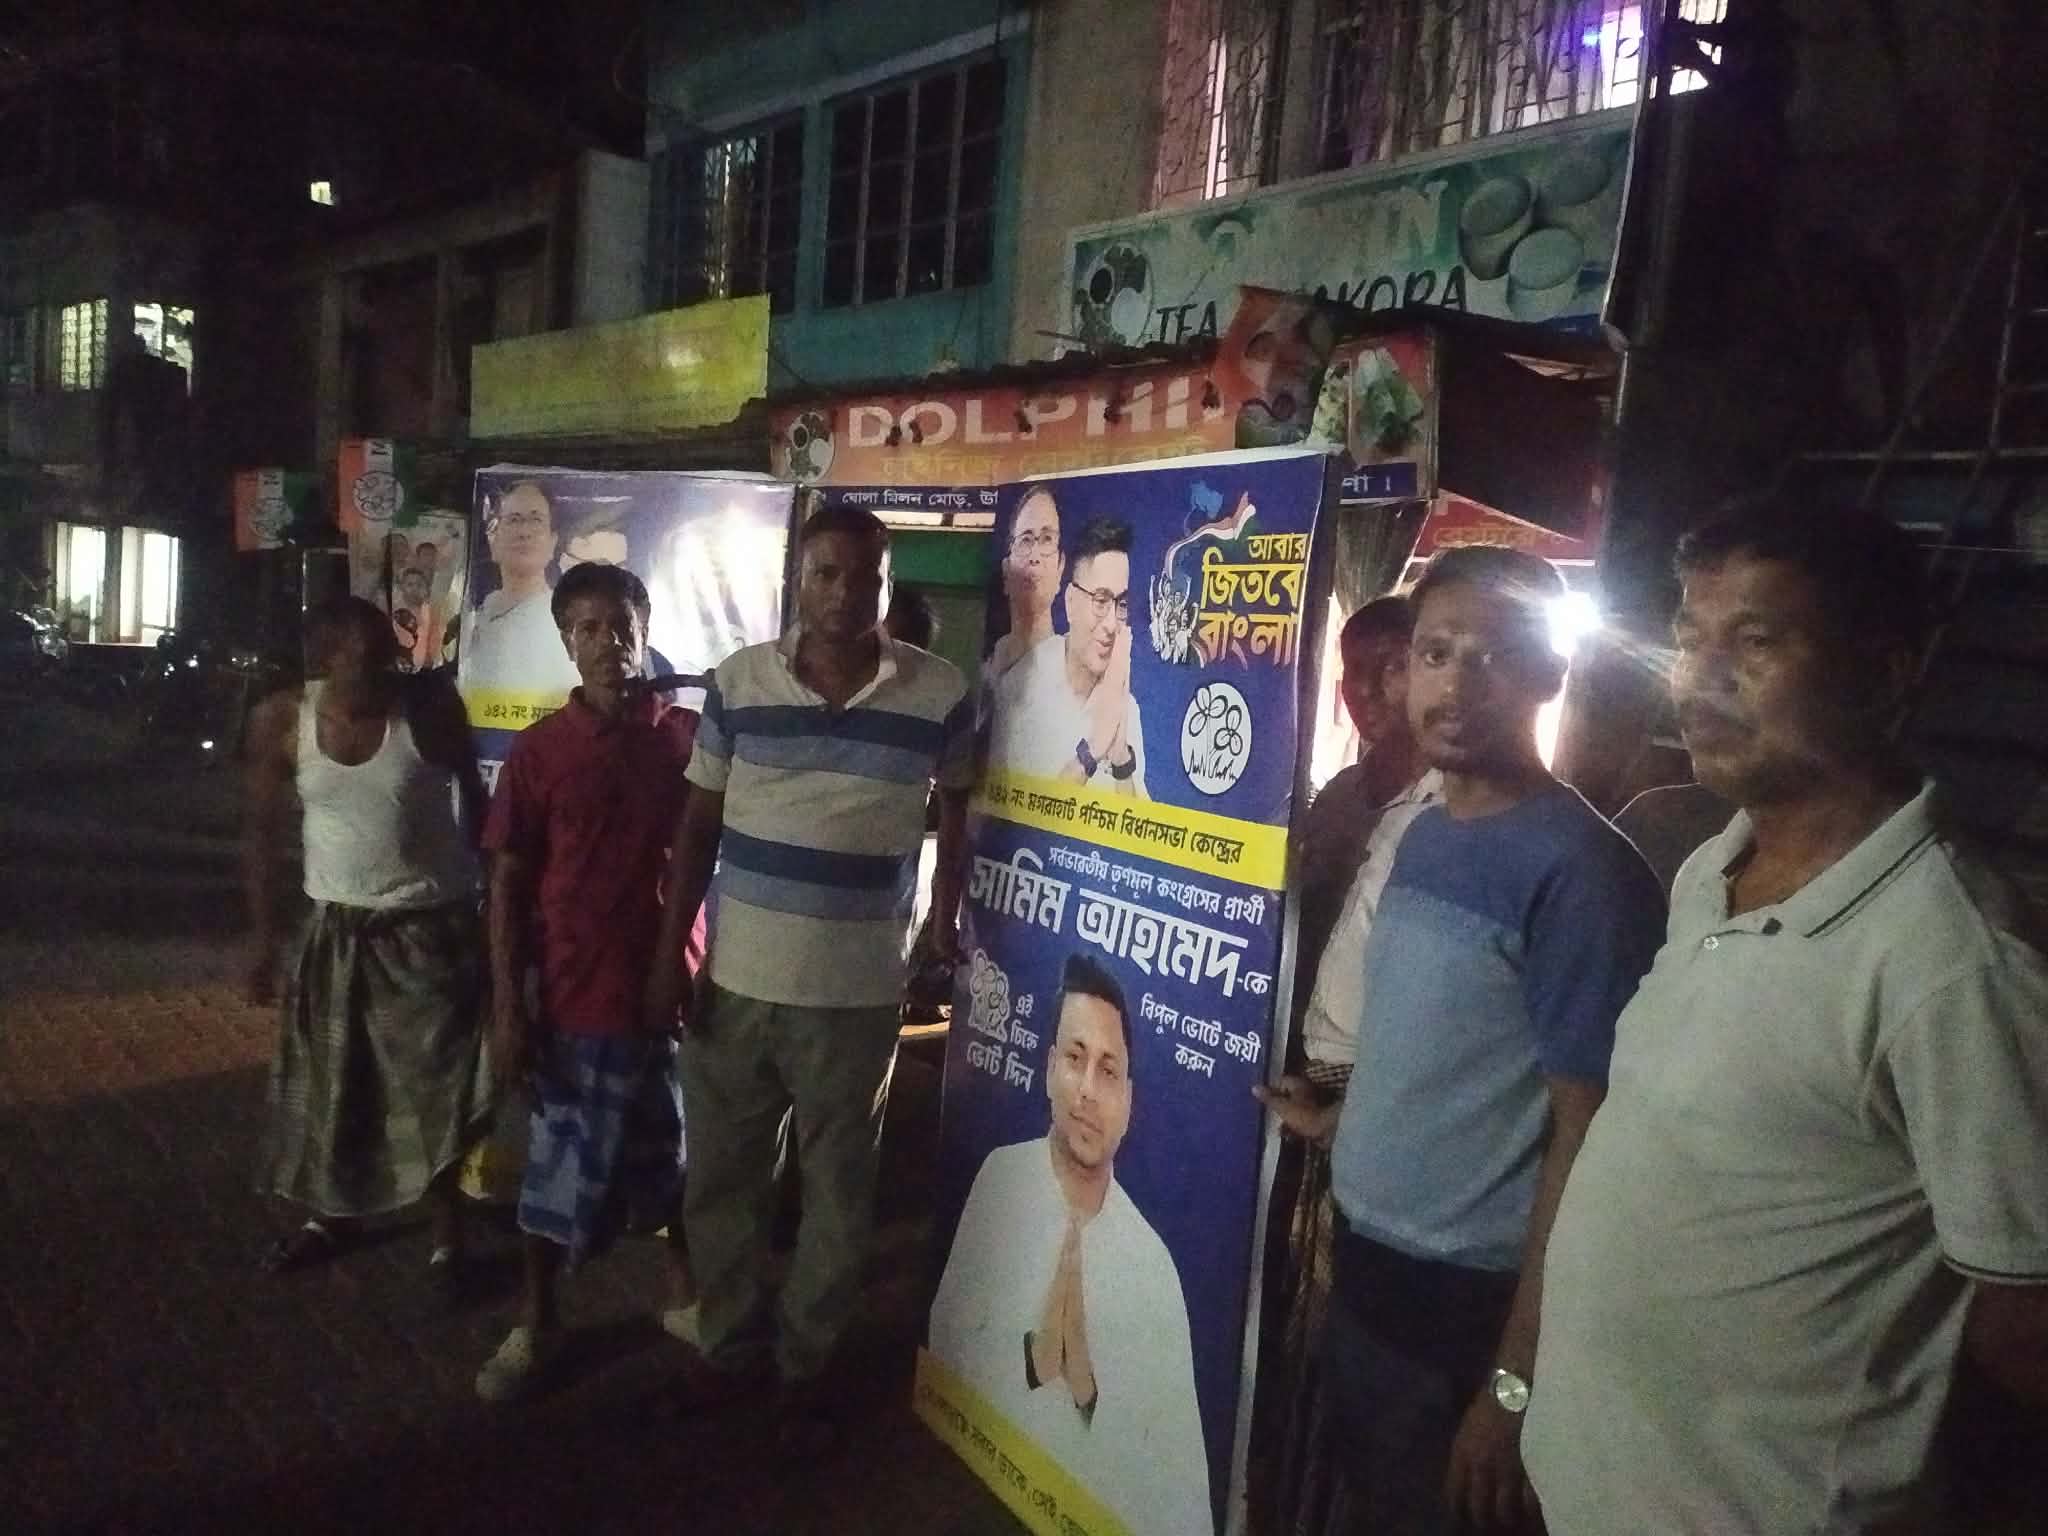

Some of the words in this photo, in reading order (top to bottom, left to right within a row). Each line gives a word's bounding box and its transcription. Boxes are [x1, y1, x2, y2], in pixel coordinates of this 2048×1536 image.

[1247, 533, 1308, 560] আবার
[1200, 547, 1305, 609] জিতবে
[1199, 612, 1298, 670] বাংলা
[511, 705, 528, 719] নং
[1011, 788, 1025, 808] নং
[1027, 793, 1077, 821] মগরাহাট
[1079, 802, 1118, 832] পশ্চিম
[1121, 808, 1188, 849] বিধানসভা
[1190, 831, 1244, 864] কেন্দ্রের
[968, 847, 1071, 935] সামিম
[1049, 846, 1109, 882] সর্বভারতীয়
[1111, 864, 1155, 899] তৃণমূল
[1157, 877, 1221, 915] কংগ্রেসের
[1224, 889, 1266, 926] প্রার্থী
[1015, 994, 1034, 1018] এই
[1140, 992, 1180, 1034] বিপুল
[1181, 1015, 1222, 1047] ভোটে
[1224, 1031, 1262, 1064] জয়ী
[967, 1041, 1003, 1075] ভোট
[1004, 1051, 1035, 1093] দিন
[1174, 1043, 1216, 1079] করুন
